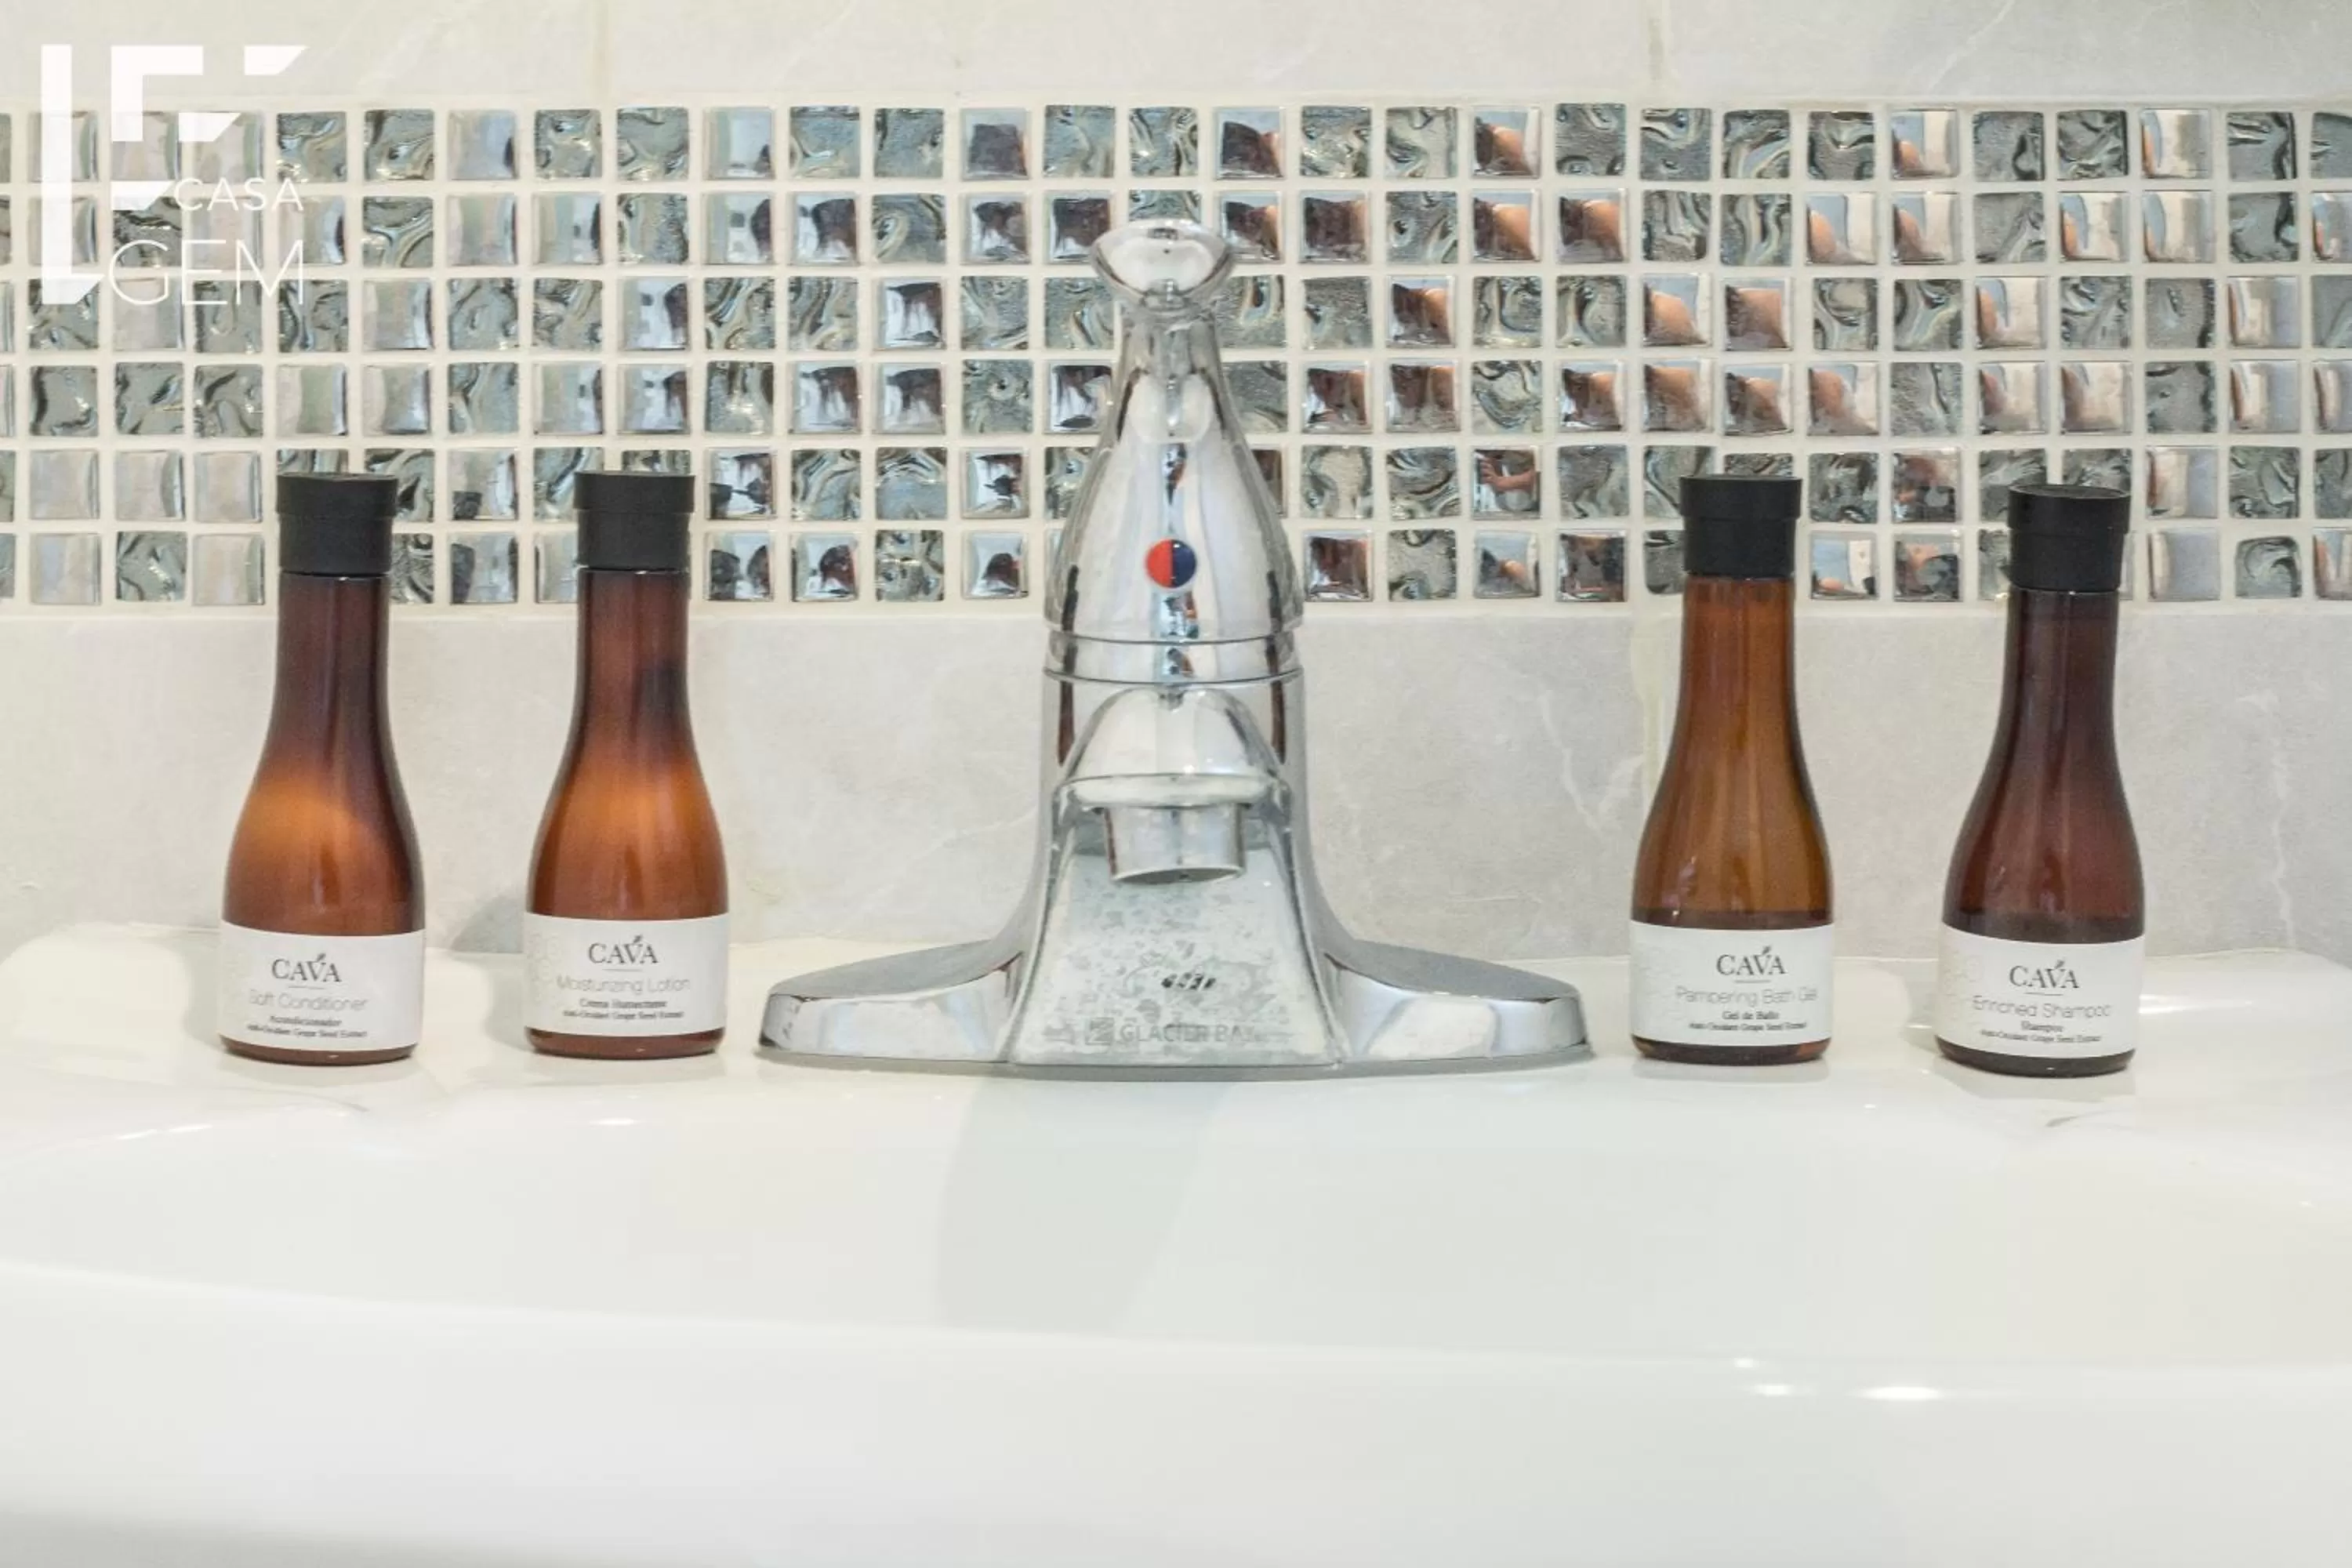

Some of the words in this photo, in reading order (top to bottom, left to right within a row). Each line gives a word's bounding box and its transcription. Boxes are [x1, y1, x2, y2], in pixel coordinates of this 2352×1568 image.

[647, 977, 690, 993] Lotion
[278, 992, 369, 1012] Conditioner
[2042, 1002, 2112, 1019] Shampoo
